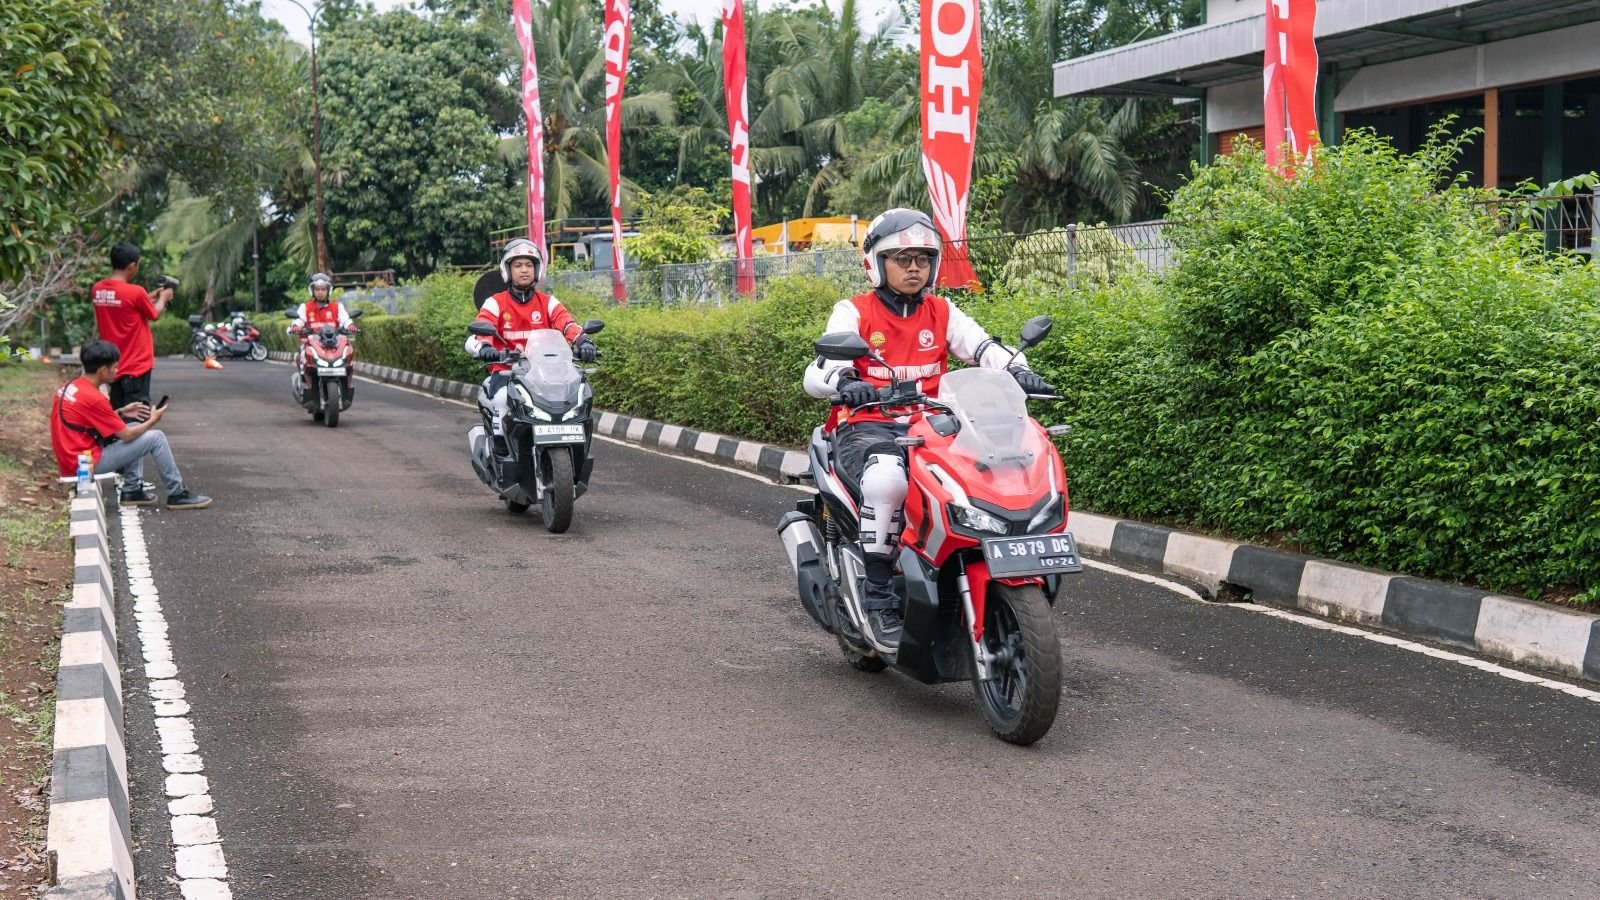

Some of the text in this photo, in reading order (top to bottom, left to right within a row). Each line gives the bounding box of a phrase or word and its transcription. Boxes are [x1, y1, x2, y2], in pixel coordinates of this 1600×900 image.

[993, 538, 1070, 559] A 5879 DG
